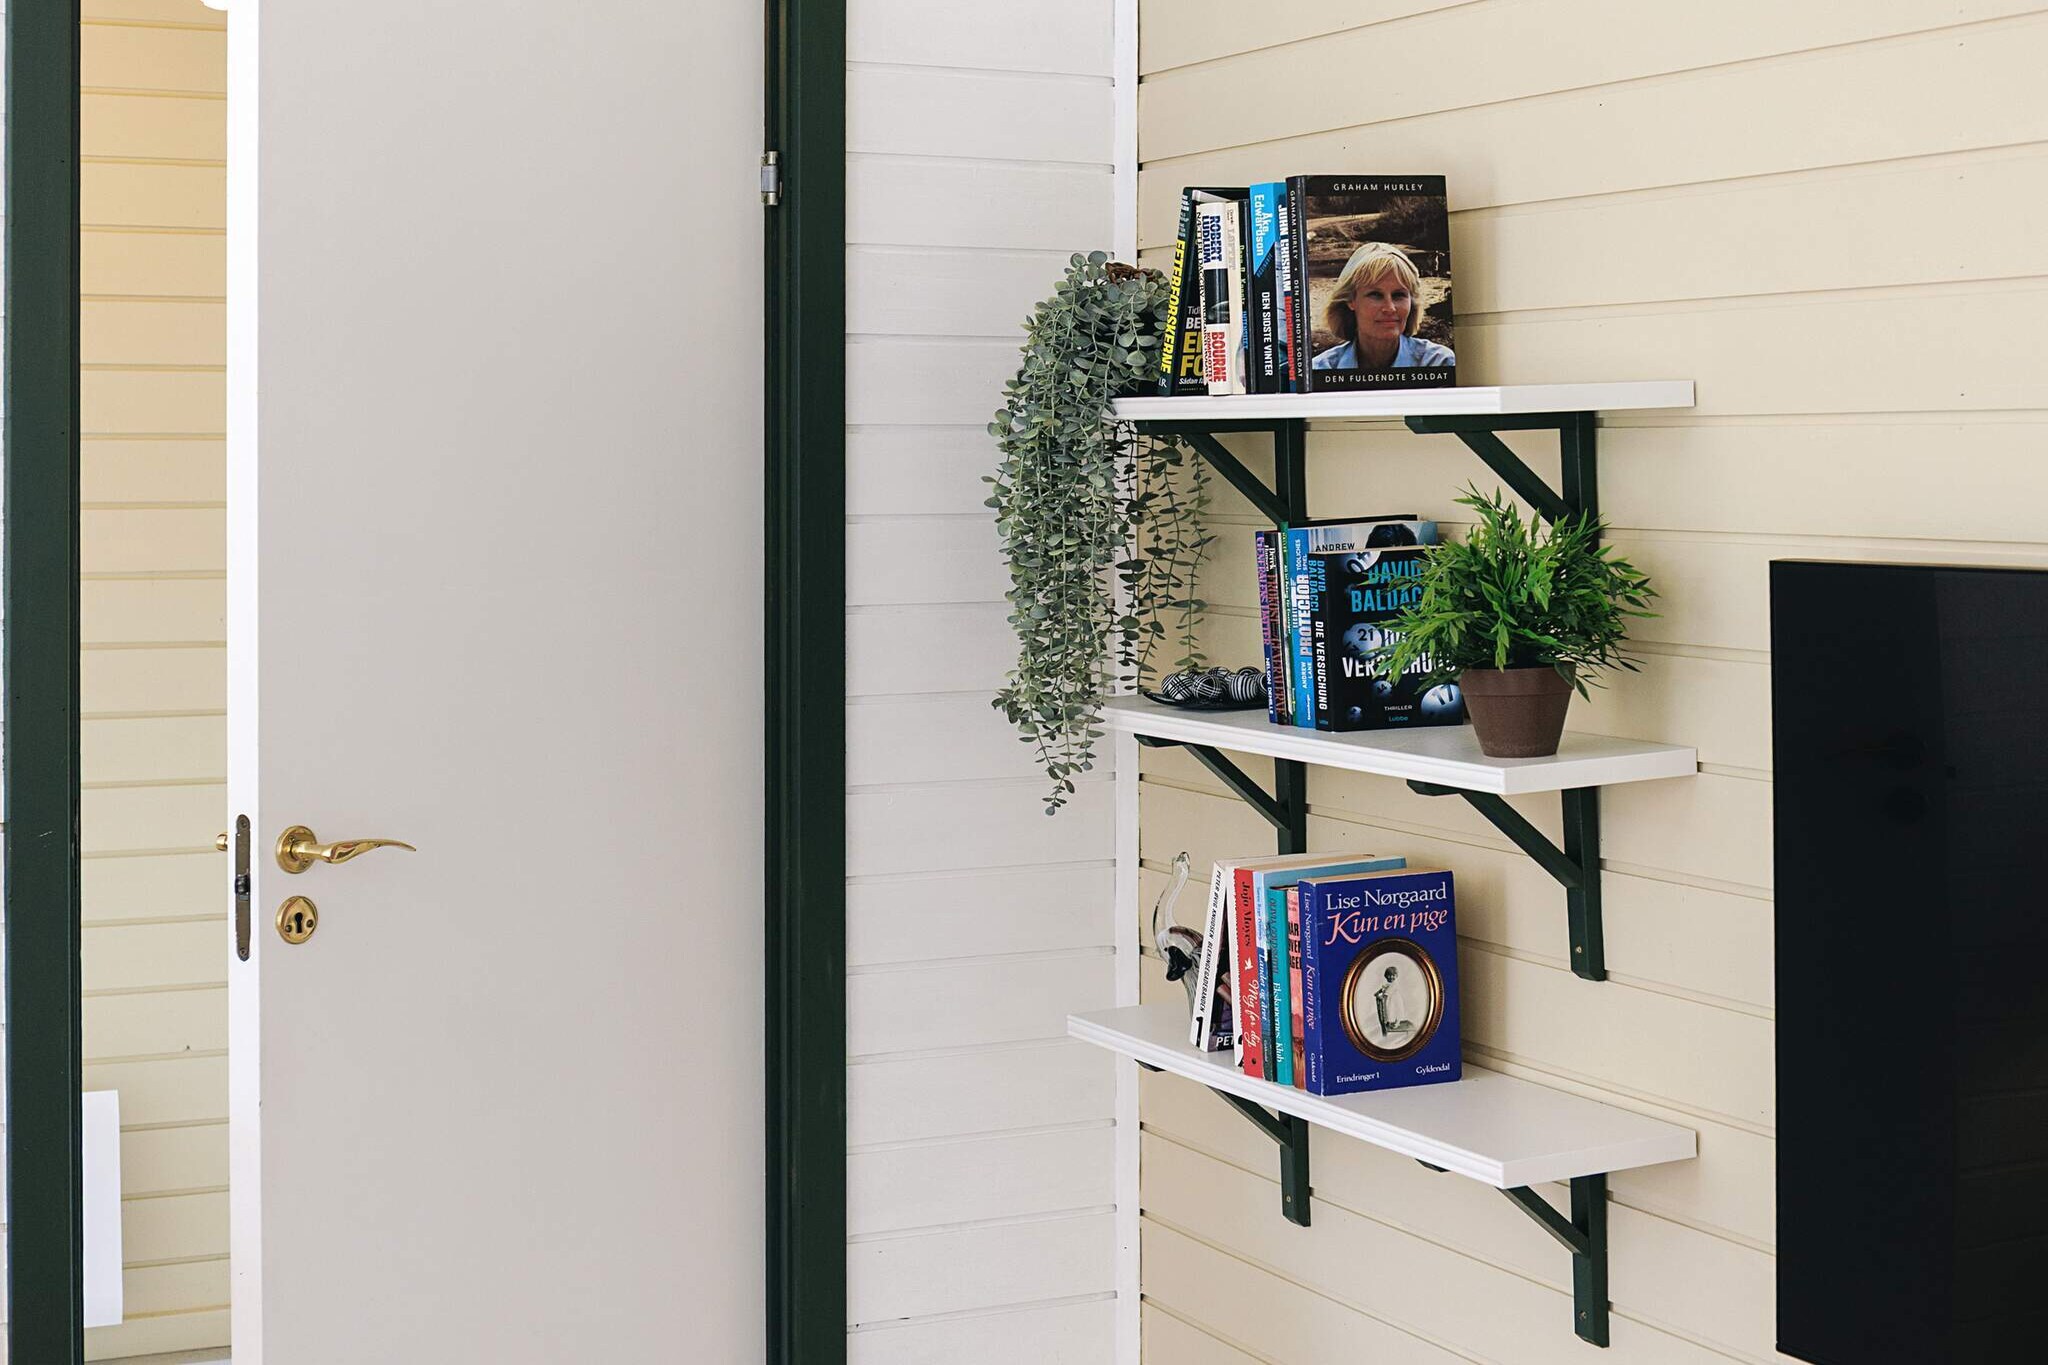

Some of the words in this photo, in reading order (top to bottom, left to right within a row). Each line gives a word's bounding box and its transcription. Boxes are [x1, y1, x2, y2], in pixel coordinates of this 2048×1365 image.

[1333, 183, 1379, 191] GRAHAM
[1384, 183, 1424, 191] HURLEY
[1254, 194, 1265, 256] Edwardson
[1277, 204, 1288, 234] JOHN
[1202, 215, 1211, 263] LUDLUM
[1209, 215, 1223, 262] ROBERT
[1280, 238, 1292, 292] GRISHAM
[1160, 239, 1186, 374] EFTERFORSKERNE
[1261, 291, 1270, 310] DEN
[1262, 312, 1272, 344] SIDSTE
[1206, 332, 1214, 382] KOMPLOTTET
[1211, 331, 1227, 383] BOURNE
[1264, 345, 1273, 376] VINTER
[1325, 375, 1345, 383] DEN
[1349, 373, 1406, 382] FULDENDTE
[1411, 372, 1449, 381] SOLDAT
[1315, 543, 1356, 552] ANDREW
[1308, 560, 1319, 612] BALDACCI
[1317, 560, 1326, 592] DAVID
[1351, 586, 1423, 613] BALDAC
[1293, 574, 1312, 656] PROTECTOR
[1315, 621, 1325, 638] DIE
[1358, 628, 1374, 642] 21
[1316, 639, 1328, 710] VERSUCHUNG
[1214, 870, 1222, 890] PETER
[1241, 881, 1250, 907] Jojo
[1325, 893, 1360, 911] Lise
[1364, 881, 1447, 909] Nørgaard
[1208, 909, 1217, 939] KNUDSEN
[1242, 911, 1252, 947] Moyes
[1304, 914, 1314, 960] Nørgaard
[1324, 911, 1382, 946] Kun
[1383, 914, 1405, 930] en
[1410, 904, 1448, 934] pige
[1259, 953, 1268, 988] Landet
[1305, 964, 1316, 989] Kun
[1242, 979, 1260, 1008] Mig
[1260, 989, 1267, 999] og
[1307, 991, 1314, 1004] en
[1306, 1005, 1316, 1030] pige
[1243, 1030, 1261, 1048] dig
[1276, 1042, 1285, 1062] Klub
[1336, 1072, 1376, 1084] Erindringer
[1415, 1063, 1450, 1075] Gyldendal
